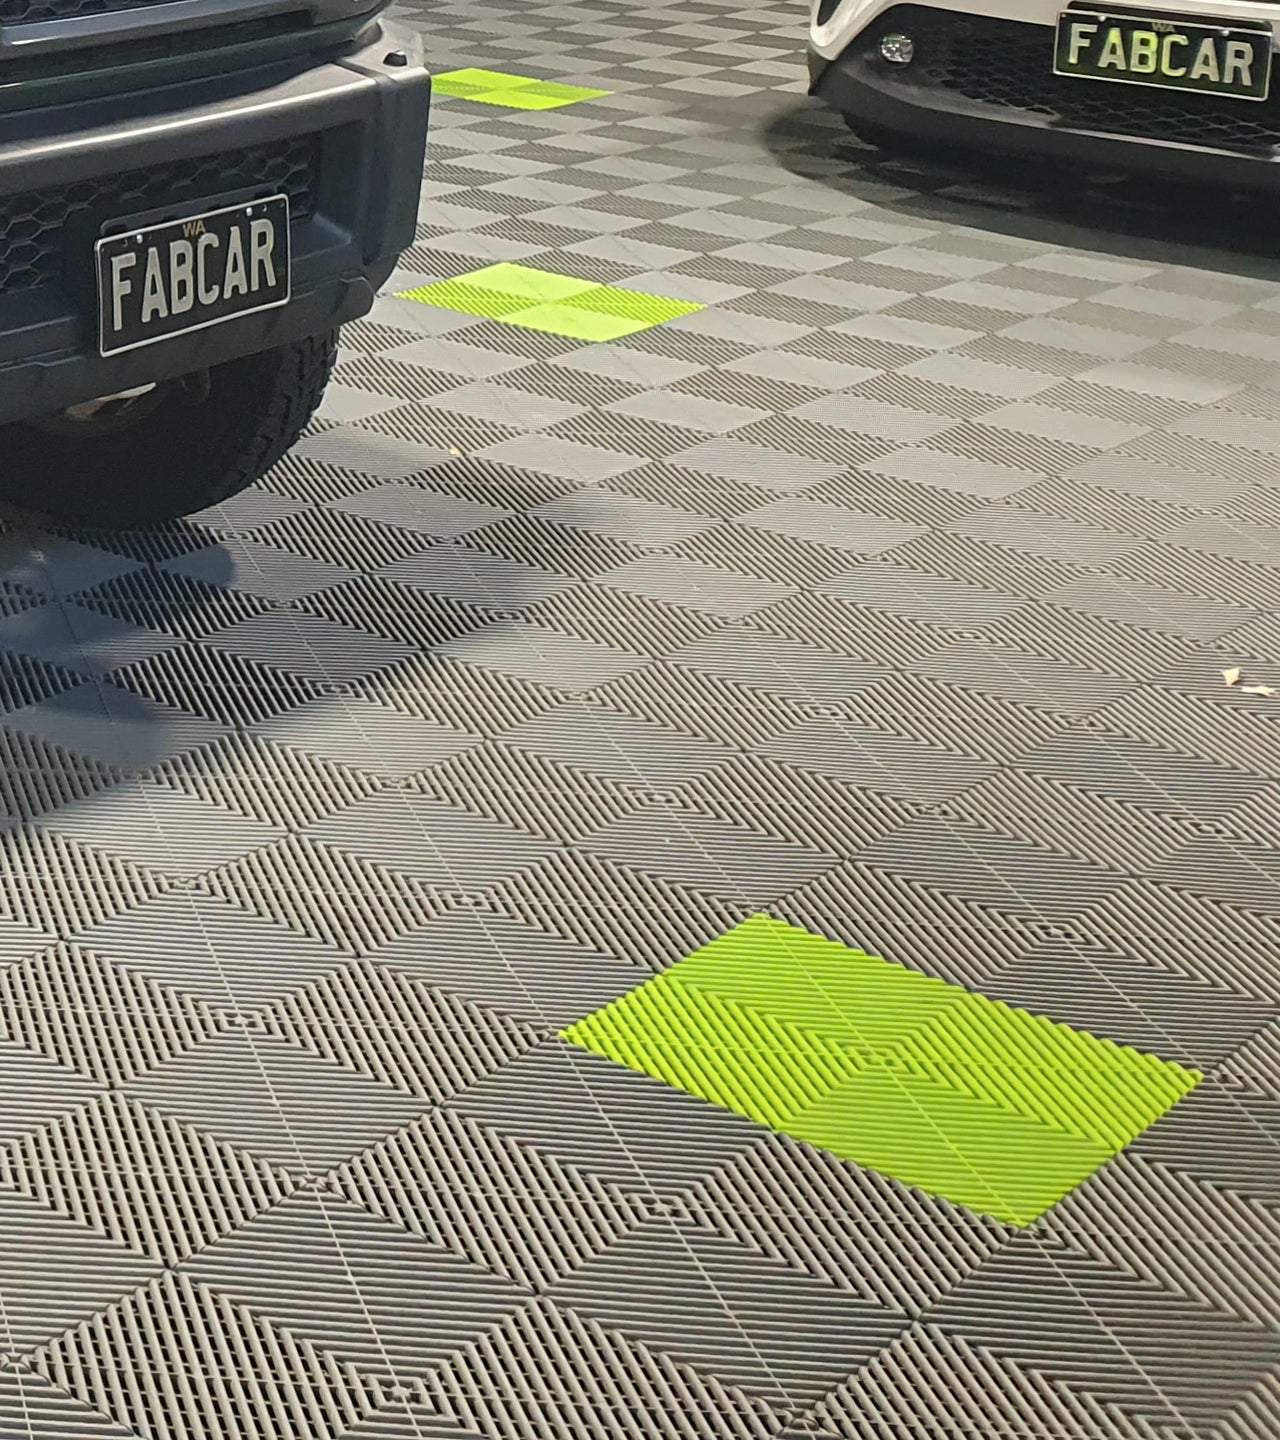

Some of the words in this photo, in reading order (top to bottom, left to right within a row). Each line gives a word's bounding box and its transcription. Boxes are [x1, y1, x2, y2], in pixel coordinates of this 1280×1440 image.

[1152, 22, 1175, 34] WA
[1068, 23, 1253, 86] FABCAR
[183, 220, 206, 238] WA
[111, 218, 276, 331] FABCAR
